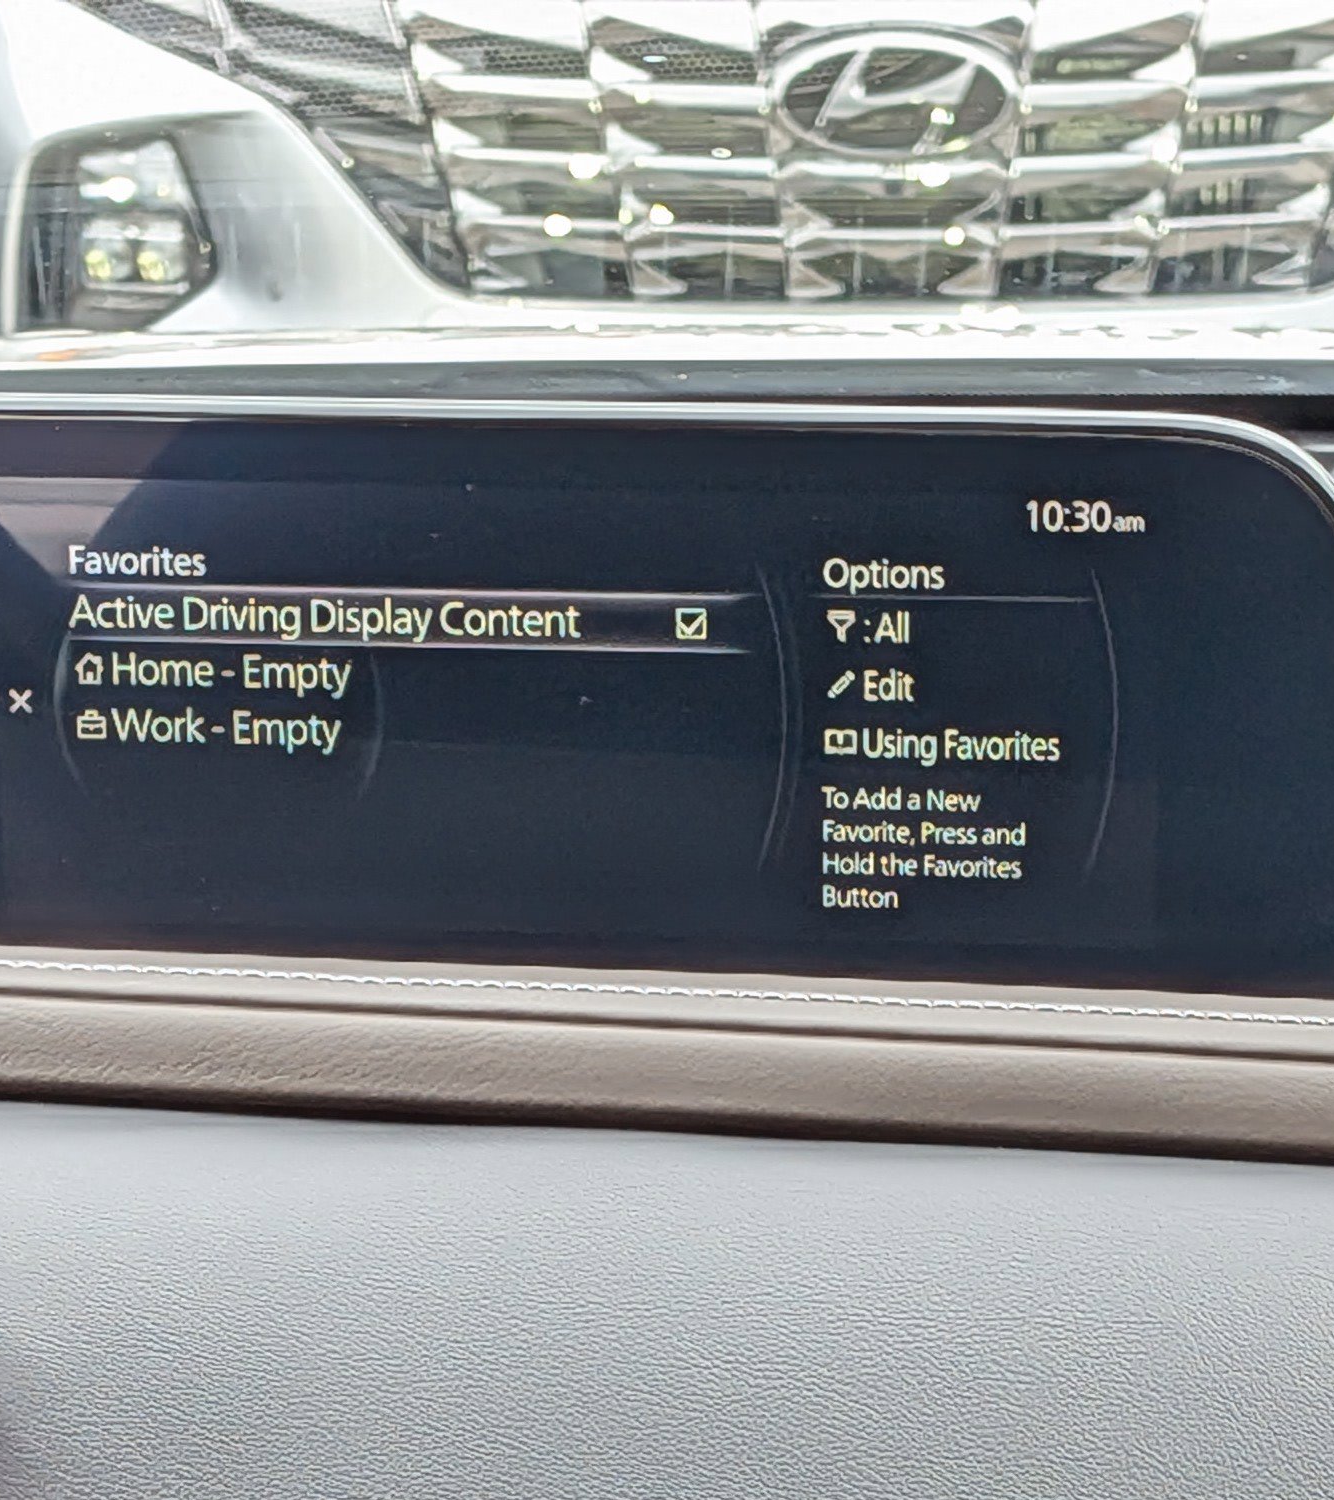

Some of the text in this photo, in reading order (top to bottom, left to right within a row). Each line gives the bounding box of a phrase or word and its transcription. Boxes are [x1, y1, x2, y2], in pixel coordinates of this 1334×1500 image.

[68, 544, 207, 577] Favorites
[822, 557, 946, 596] Options
[68, 593, 582, 643] Active Driving Display Content
[111, 651, 215, 688] Home
[242, 653, 353, 700] Empty
[863, 667, 916, 702] Edit
[110, 705, 206, 744] Work
[232, 709, 342, 756] Empty
[862, 727, 1061, 768] Using Favorites
[821, 785, 983, 813] To Add a New
[822, 819, 1027, 848] Favorite, Press and
[822, 850, 1023, 880] Hold the Favorites
[822, 883, 899, 909] Button
